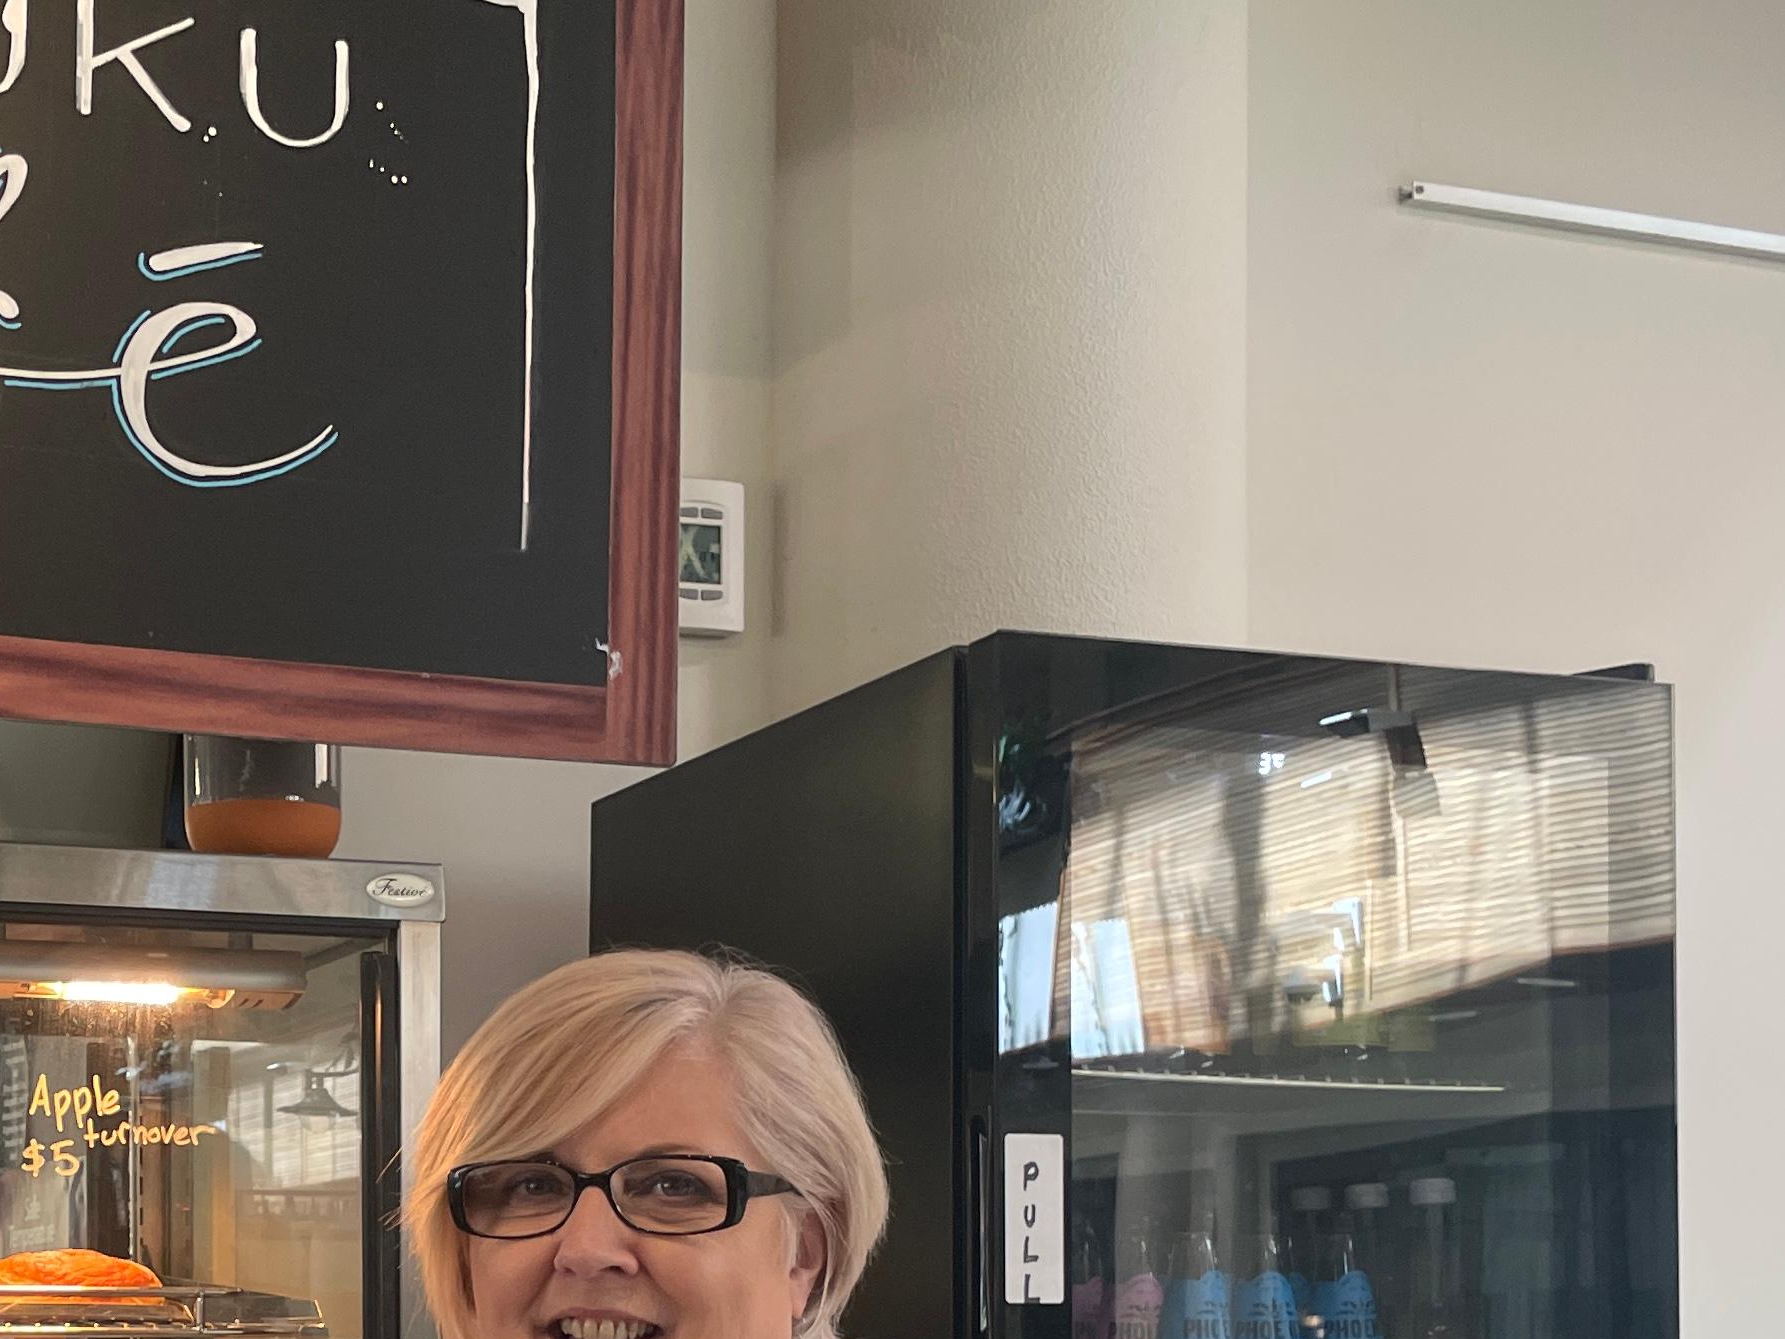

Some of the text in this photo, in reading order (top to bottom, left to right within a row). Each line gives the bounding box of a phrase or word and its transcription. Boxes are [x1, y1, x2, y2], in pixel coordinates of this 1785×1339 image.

[29, 1073, 120, 1132] Apple
[21, 1138, 80, 1177] $5
[84, 1118, 216, 1148] turnover
[1023, 1161, 1041, 1304] PULL
